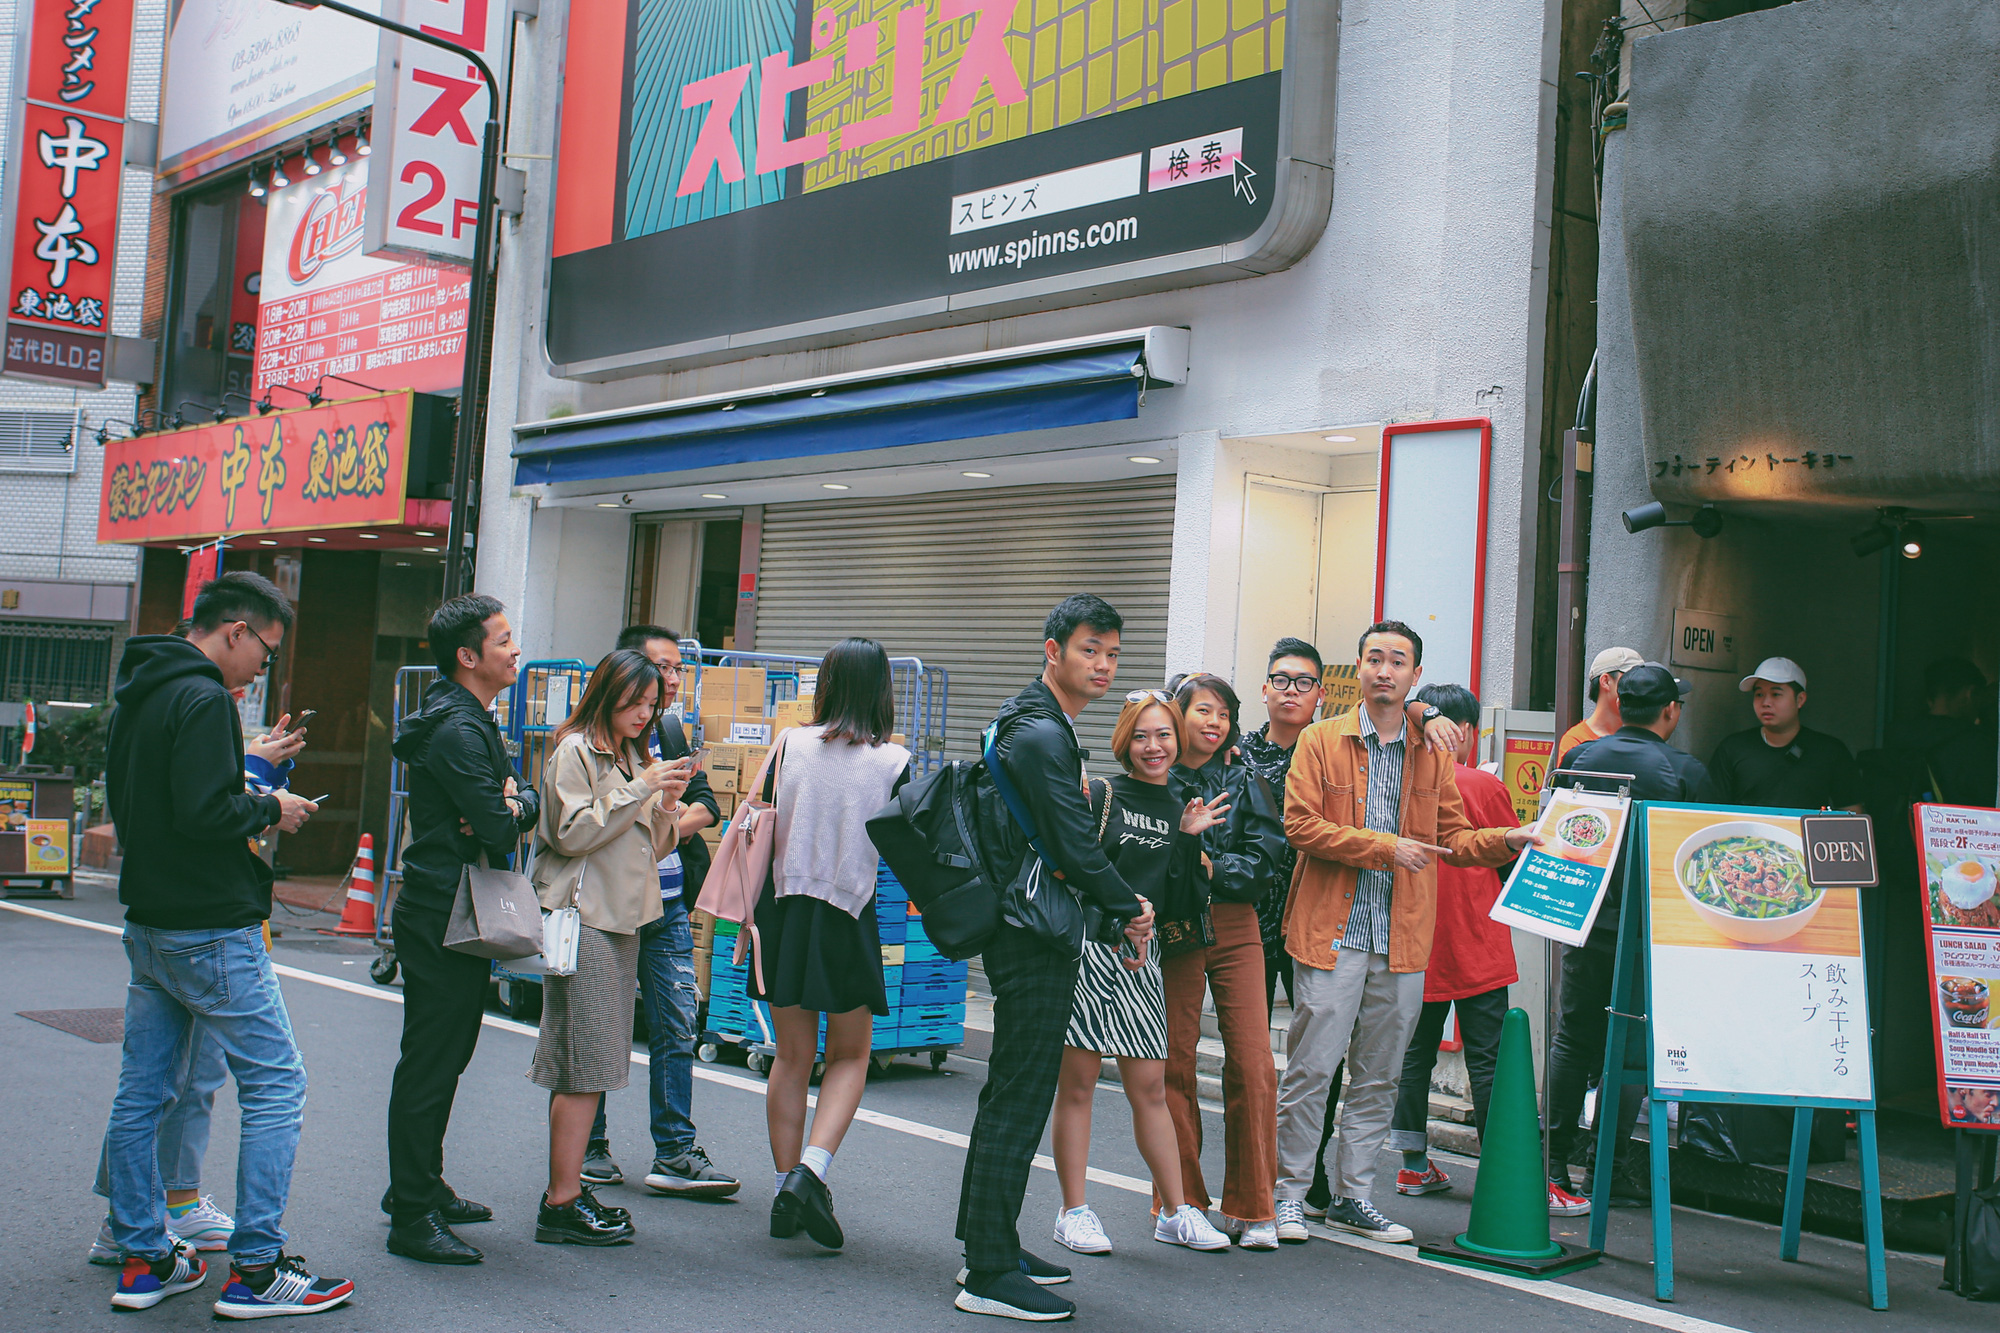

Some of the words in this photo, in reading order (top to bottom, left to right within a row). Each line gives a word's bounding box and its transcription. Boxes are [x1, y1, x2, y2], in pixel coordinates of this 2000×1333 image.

[1168, 141, 1222, 182] 検索
[35, 116, 109, 288] 中本
[396, 160, 479, 240] 2F
[958, 183, 1040, 225] スピンズ
[948, 216, 1138, 275] www.spinns.com
[12, 287, 104, 327] 東池袋
[8, 337, 102, 372] 近代BLD.2
[109, 457, 206, 522] 蒙古タンメン
[221, 417, 287, 528] 中本
[302, 421, 390, 502] 東池袋
[1683, 626, 1715, 653] OPEN
[1324, 683, 1356, 700] STAFF
[1514, 740, 1551, 751] 通報します
[1121, 807, 1170, 836] WILD
[1813, 841, 1866, 863] OPEN
[1939, 940, 1963, 949] LUNCH
[1964, 942, 1987, 951] SALAD
[1799, 962, 1821, 1023] スープ
[1825, 962, 1850, 1077] 飲み干せる
[1949, 1045, 1965, 1053] Soup
[1966, 1046, 1987, 1054] Noodle
[1988, 1047, 1999, 1055] SET
